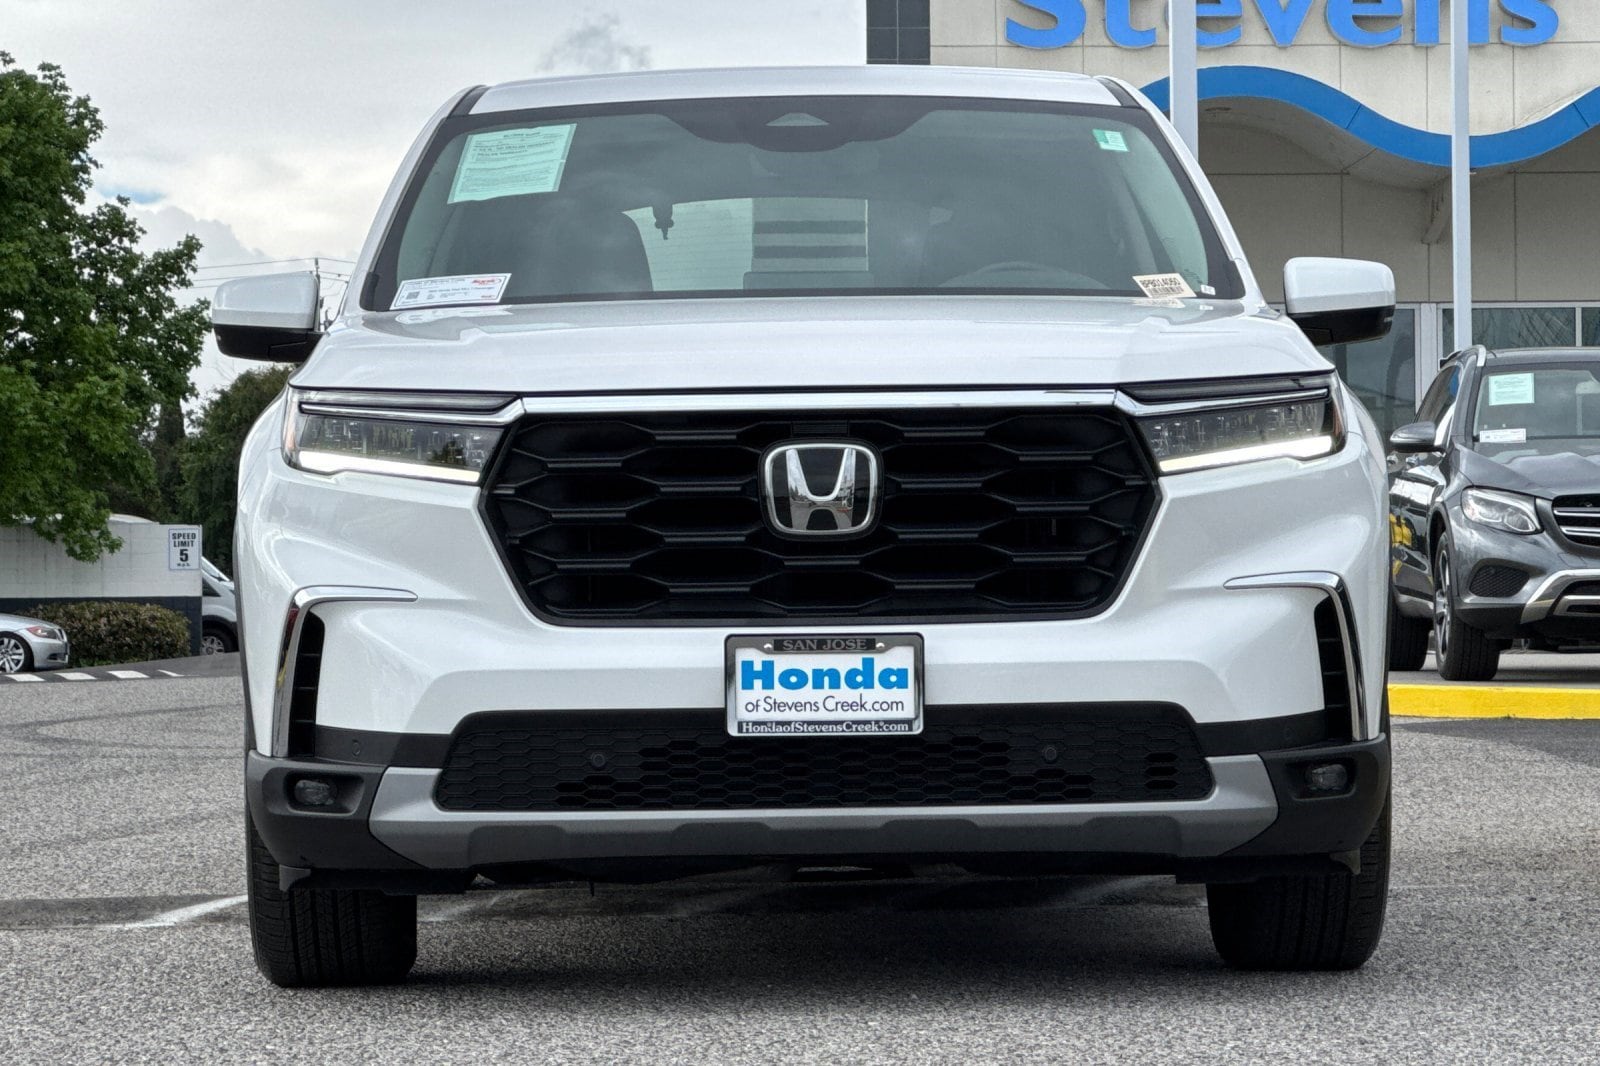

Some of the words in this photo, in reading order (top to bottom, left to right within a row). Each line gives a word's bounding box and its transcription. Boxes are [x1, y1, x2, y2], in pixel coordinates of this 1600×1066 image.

[179, 548, 188, 562] 5
[782, 639, 819, 650] SAN
[822, 638, 868, 650] JOSE
[741, 657, 909, 690] Honda
[744, 699, 762, 713] of
[763, 695, 820, 713] Stevens
[822, 693, 905, 713] Creek.com
